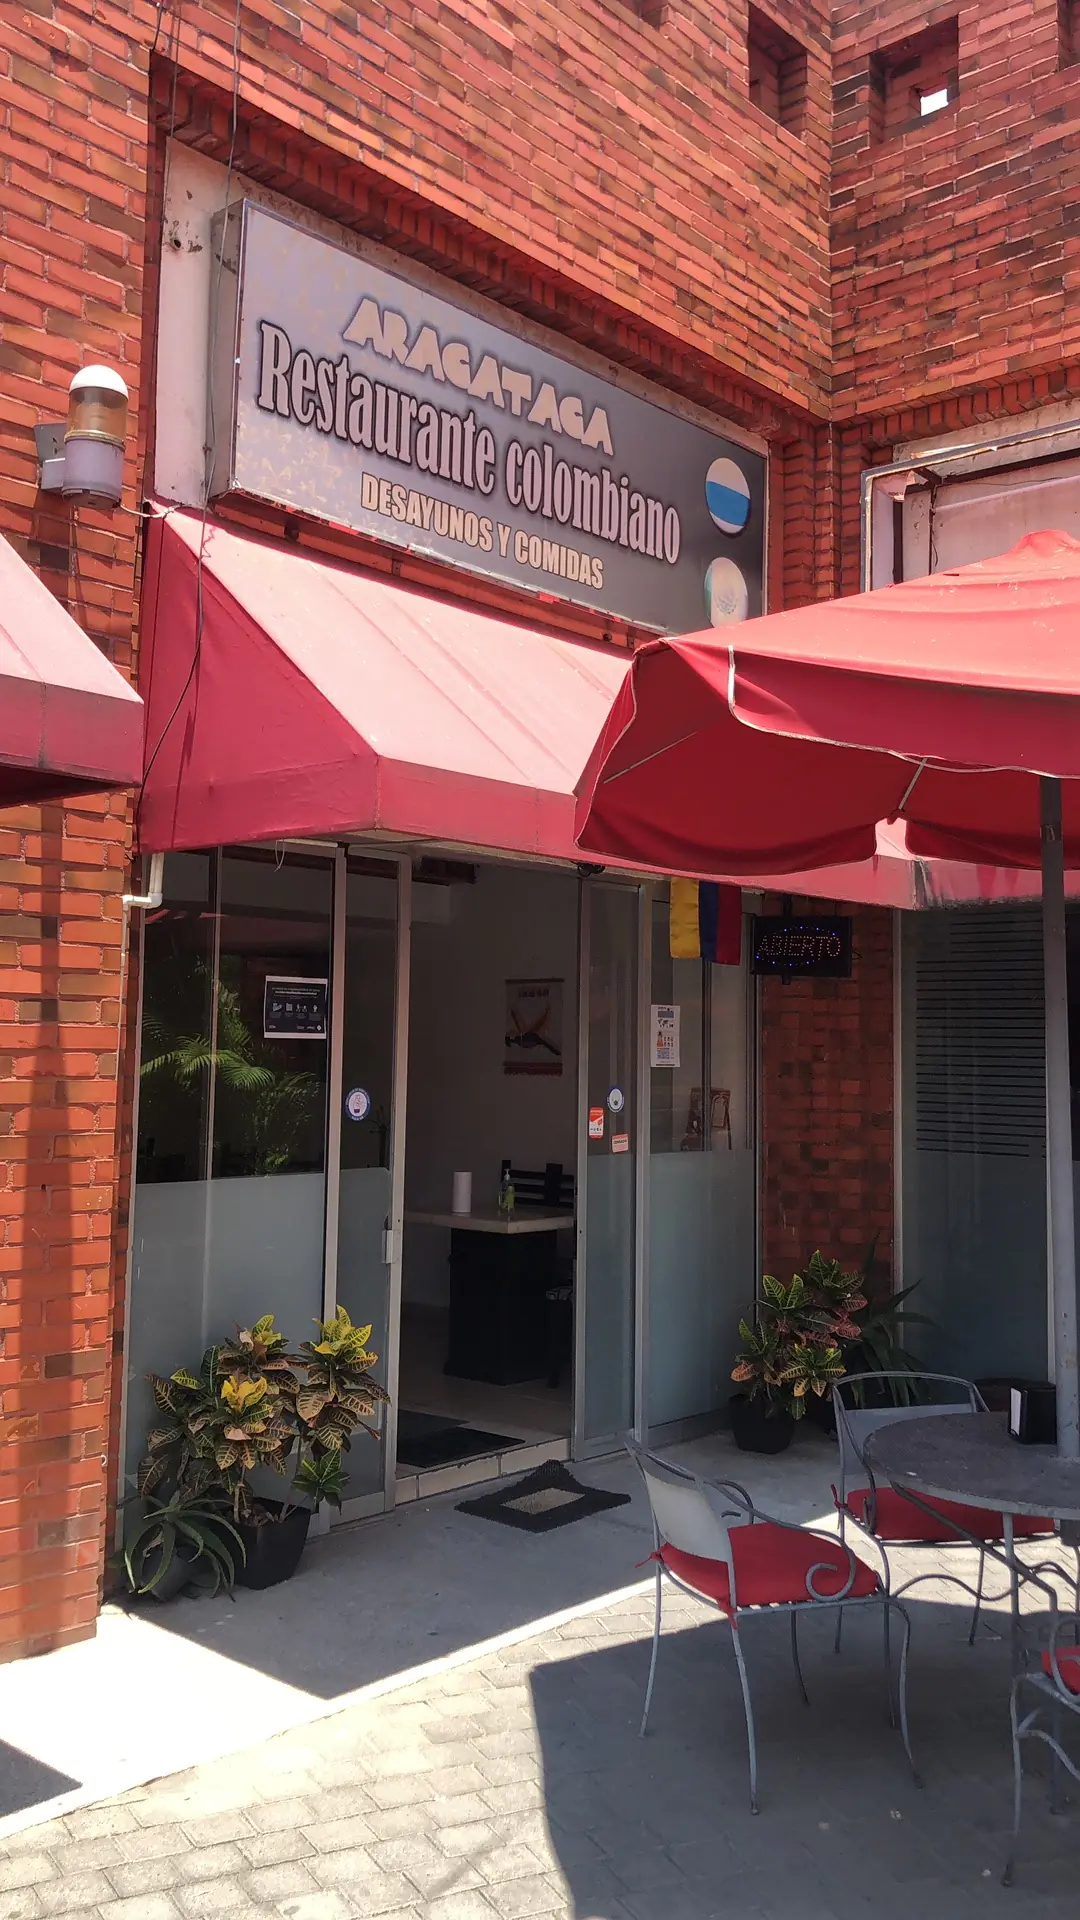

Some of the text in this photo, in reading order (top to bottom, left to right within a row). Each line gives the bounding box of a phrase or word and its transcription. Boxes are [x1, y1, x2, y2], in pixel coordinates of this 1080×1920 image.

[257, 321, 682, 564] Restaurante colombiano
[342, 298, 615, 455] ARACATACA
[361, 472, 604, 589] DESAYUNOS Y COMIDAS
[757, 935, 841, 960] ABIERTO
